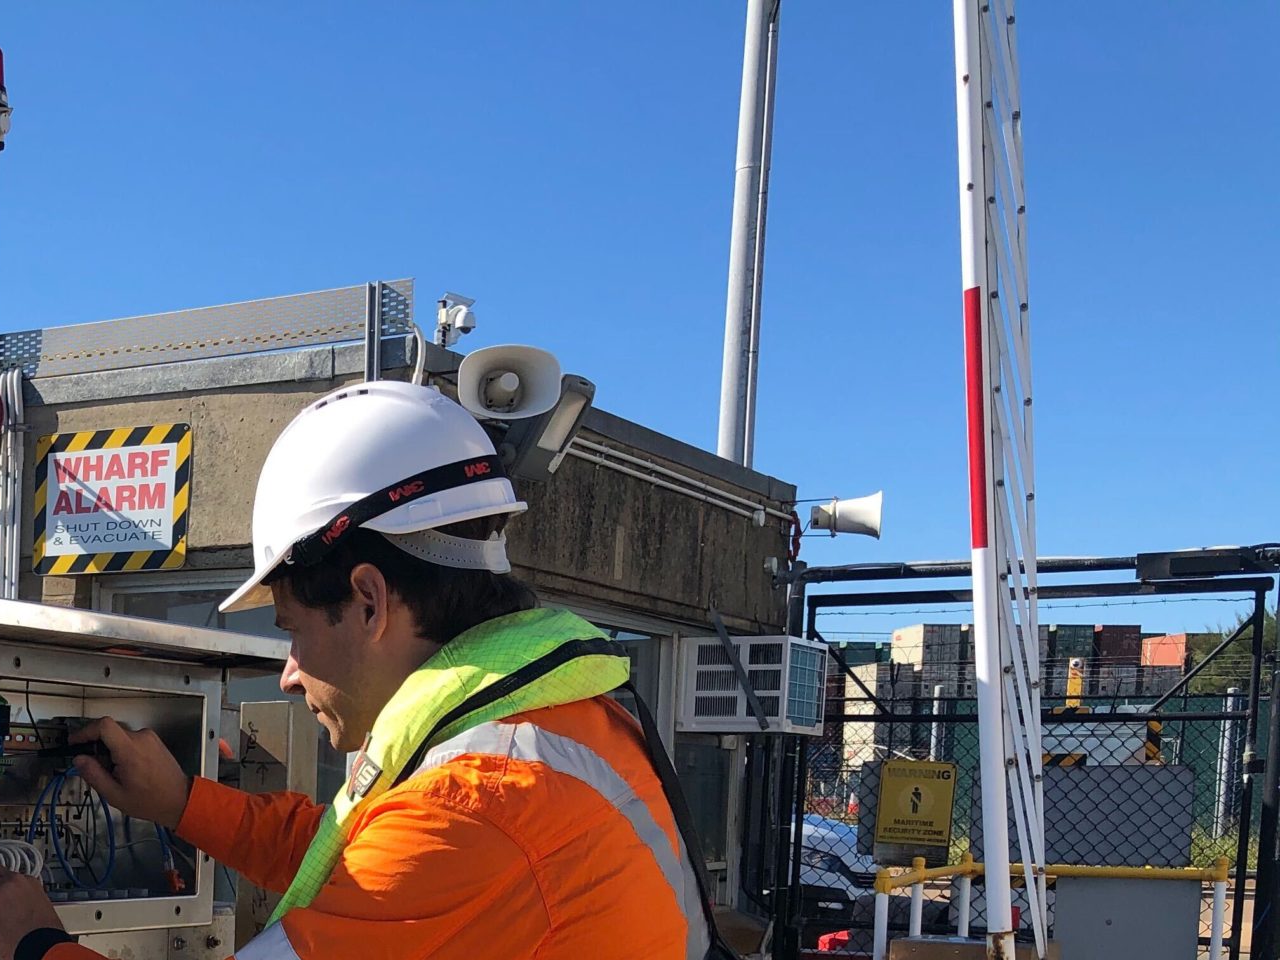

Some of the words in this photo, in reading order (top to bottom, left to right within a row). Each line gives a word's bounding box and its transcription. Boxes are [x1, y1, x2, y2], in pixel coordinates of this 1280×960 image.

[53, 449, 170, 484] WHARF
[52, 482, 167, 516] ALARM
[54, 522, 101, 534] SHUT
[106, 518, 162, 531] DOWN
[53, 536, 64, 546] &
[70, 530, 162, 544] EVACUATE
[888, 768, 951, 780] WARNING
[893, 818, 934, 827] MARITIME
[883, 827, 921, 836] SECURITY
[922, 829, 944, 837] ZONE
